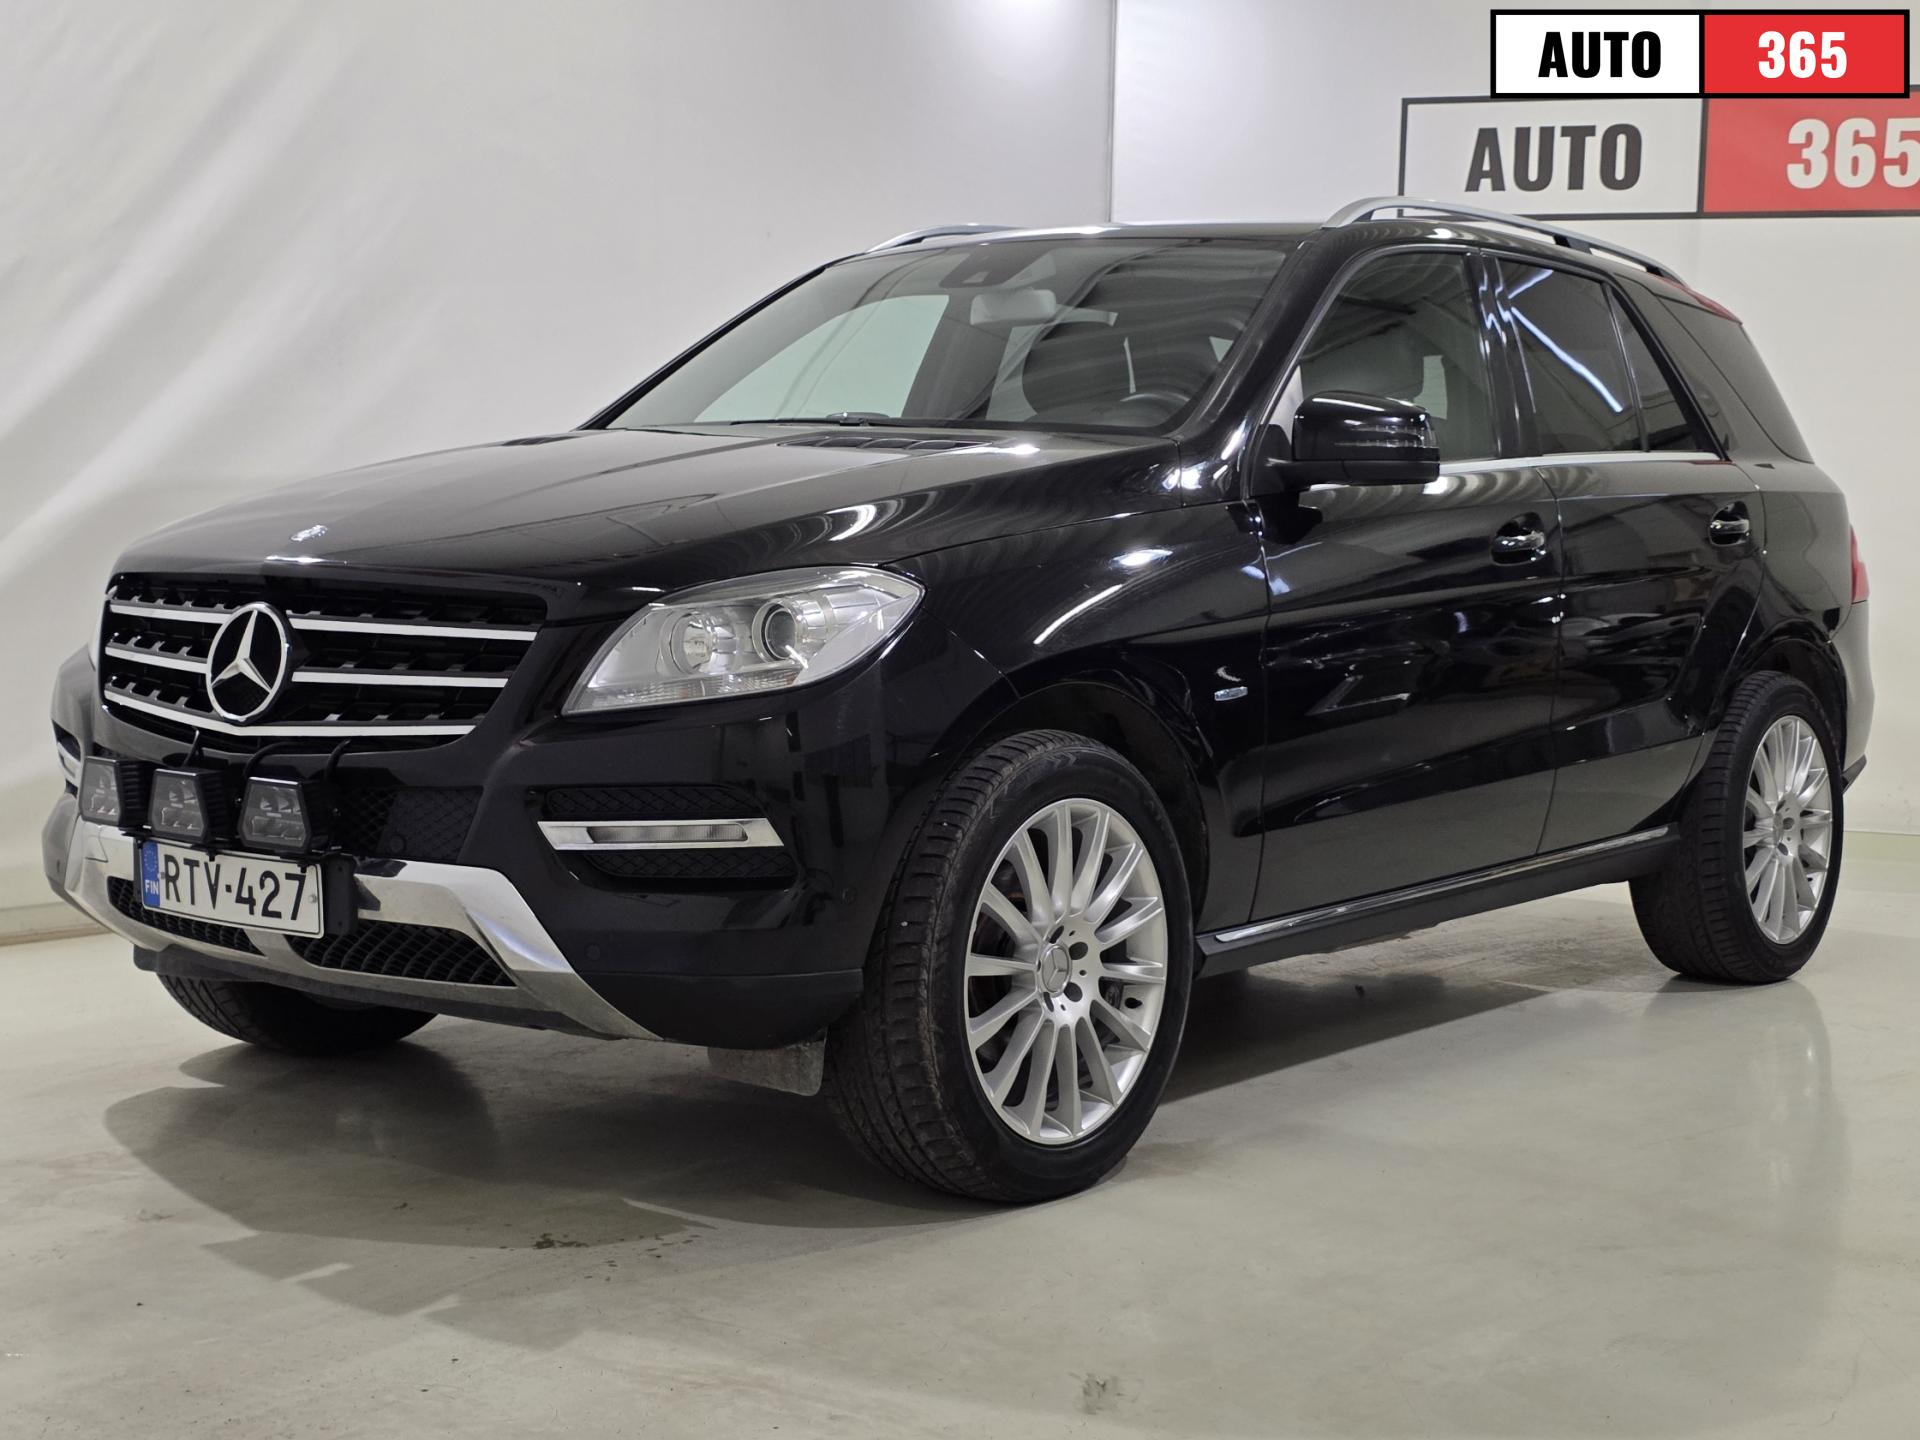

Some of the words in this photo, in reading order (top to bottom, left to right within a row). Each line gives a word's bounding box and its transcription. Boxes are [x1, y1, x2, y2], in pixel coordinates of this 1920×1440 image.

[1465, 123, 1643, 192] AUTO
[1787, 117, 1920, 189] 365
[145, 879, 159, 895] FIN
[164, 854, 307, 921] RTV-427
